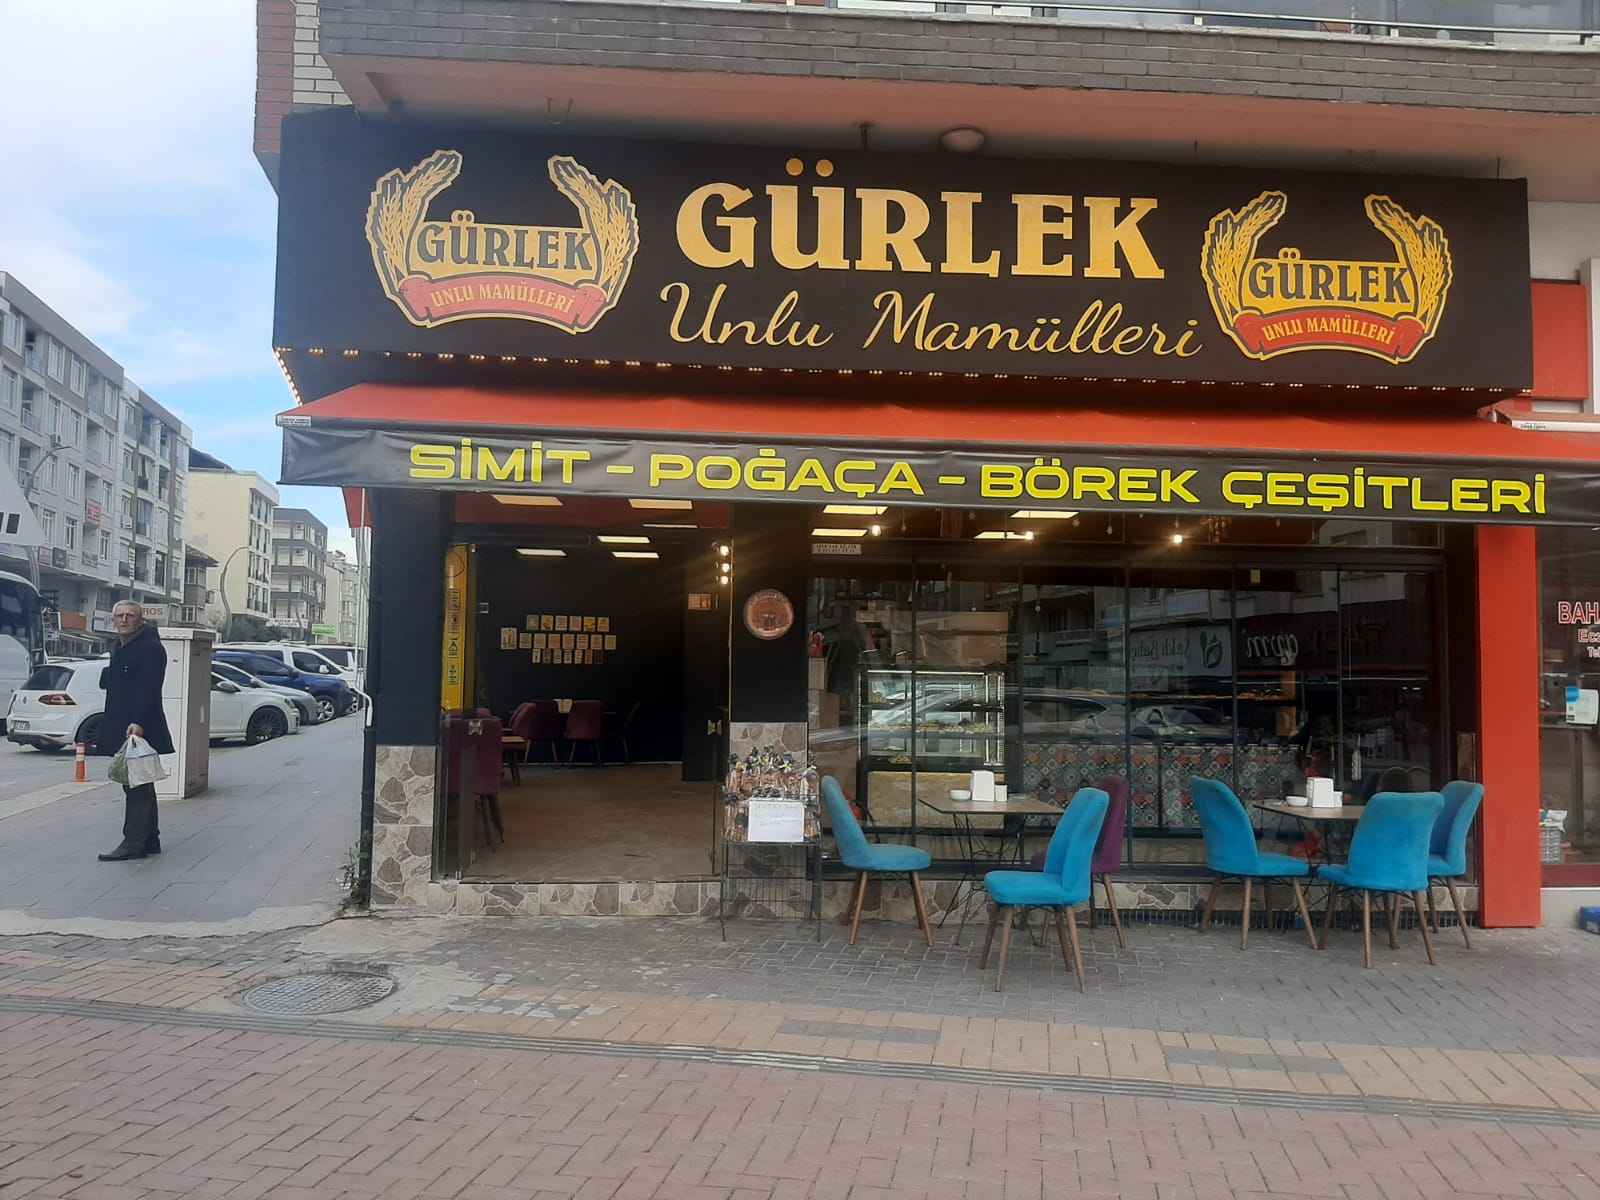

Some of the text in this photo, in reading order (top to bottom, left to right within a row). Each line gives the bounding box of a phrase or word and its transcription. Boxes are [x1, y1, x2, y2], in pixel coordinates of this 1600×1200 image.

[416, 212, 593, 272] GÜRLEK
[675, 157, 1167, 280] GÜRLEK
[429, 280, 577, 314] UNLU MAMÜLLERİ
[1248, 249, 1411, 304] GÜRLEK
[659, 281, 1204, 358] Unlu Mamülleri
[1260, 313, 1397, 346] UNLU MAMÜLLERİ
[408, 437, 591, 485] SİMİT
[649, 447, 926, 500] POĞAÇA
[980, 457, 1202, 504] BÖREK
[1222, 466, 1548, 515] ÇEŞİTLERİ
[1557, 600, 1600, 625] BAH
